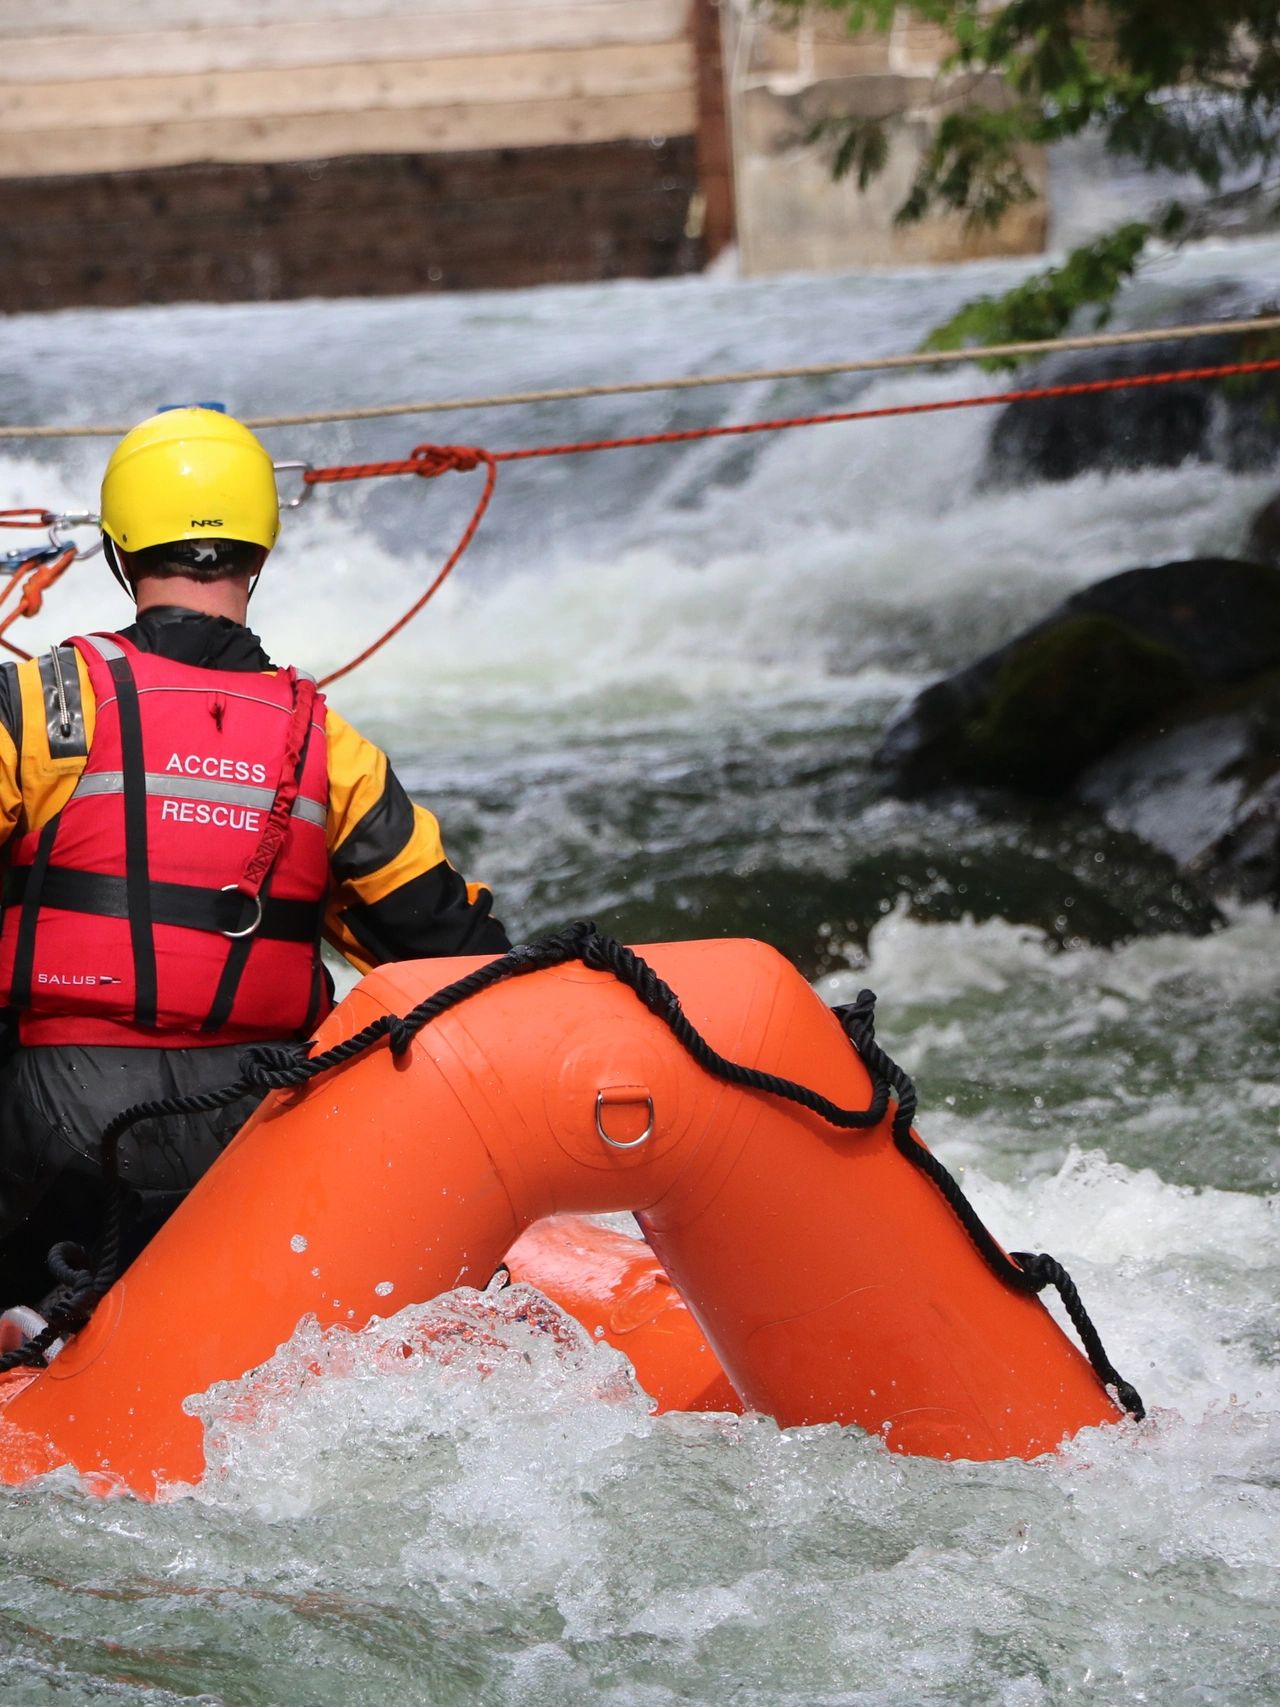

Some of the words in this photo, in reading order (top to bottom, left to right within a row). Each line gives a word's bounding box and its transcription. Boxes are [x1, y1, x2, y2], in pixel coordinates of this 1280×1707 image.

[191, 519, 224, 528] NRS
[165, 752, 266, 783] ACCESS
[161, 800, 260, 832] RESCUE
[38, 974, 97, 985] SALUS
